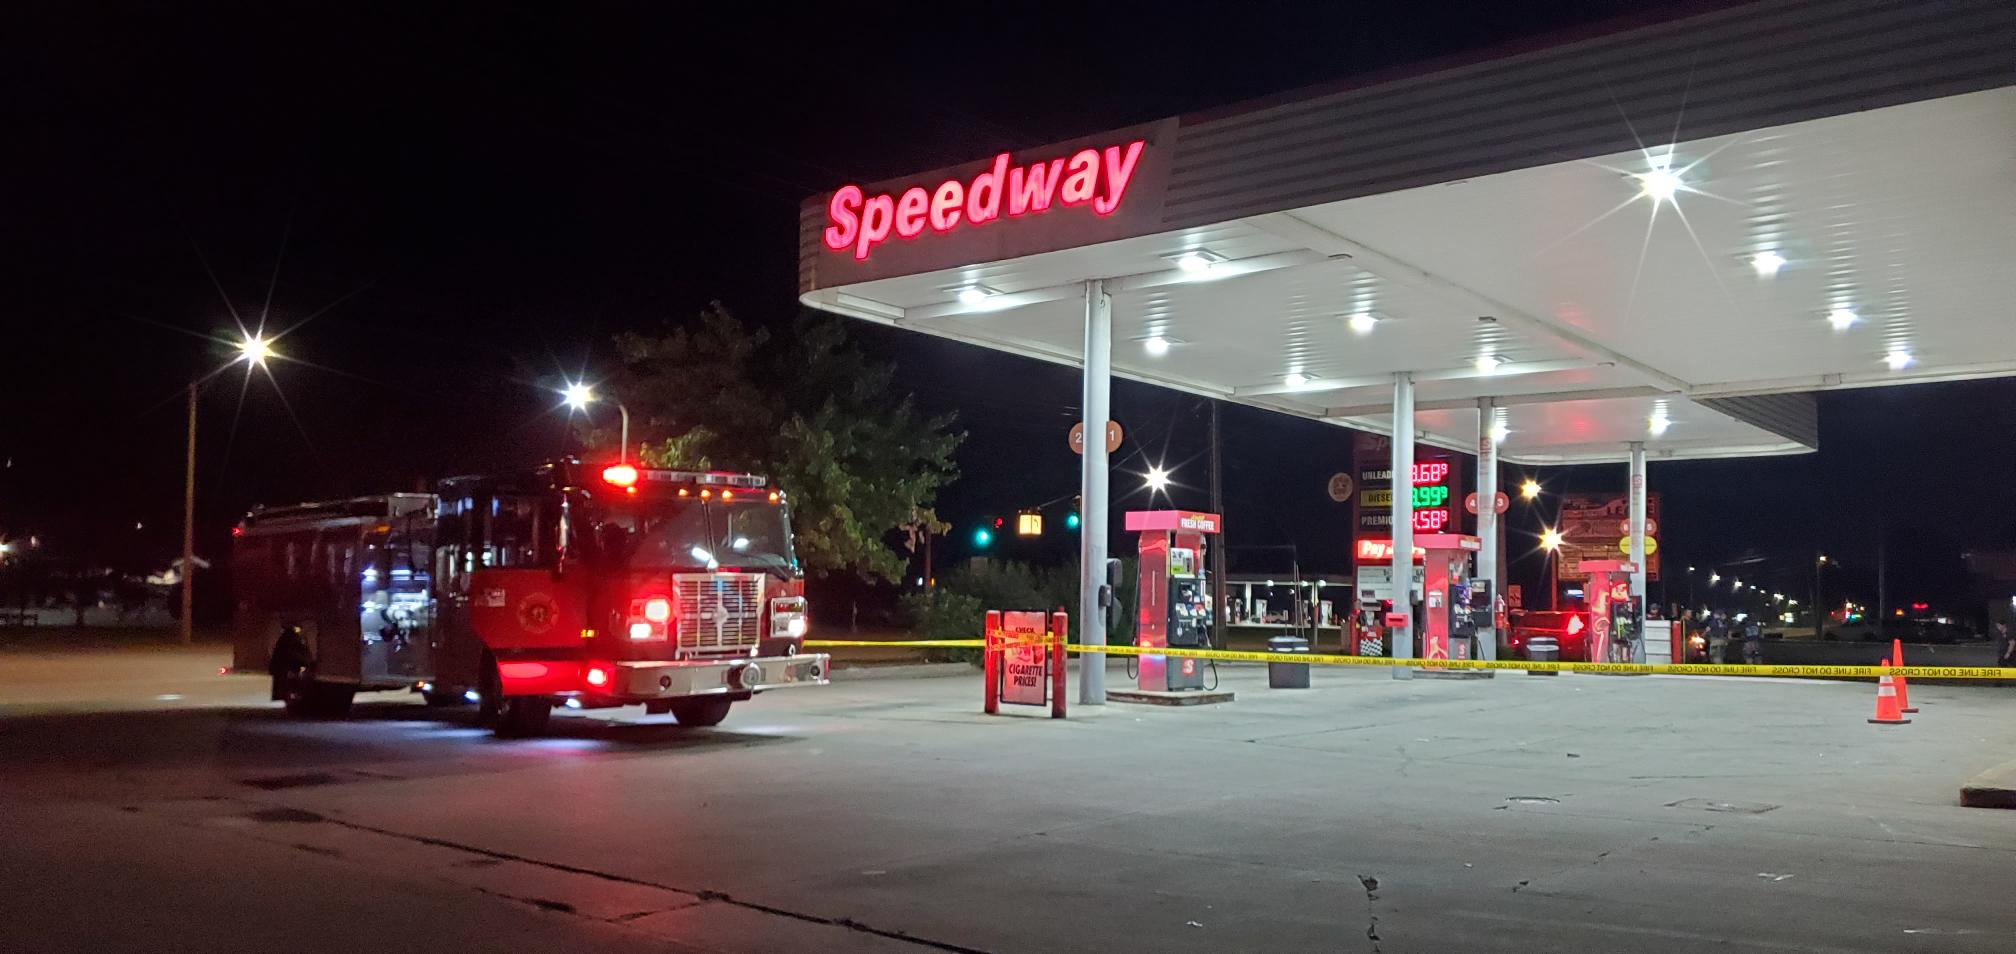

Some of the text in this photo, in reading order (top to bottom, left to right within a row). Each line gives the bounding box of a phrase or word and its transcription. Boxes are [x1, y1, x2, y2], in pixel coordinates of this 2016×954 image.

[824, 140, 1146, 260] Speedway
[1075, 433, 1082, 443] 2
[1109, 430, 1115, 441] 1
[1362, 470, 1393, 480] UNLEAD
[1361, 515, 1393, 525] PREMIU
[1363, 541, 1385, 558] Pay
[1008, 664, 1043, 676] CIGARETTE
